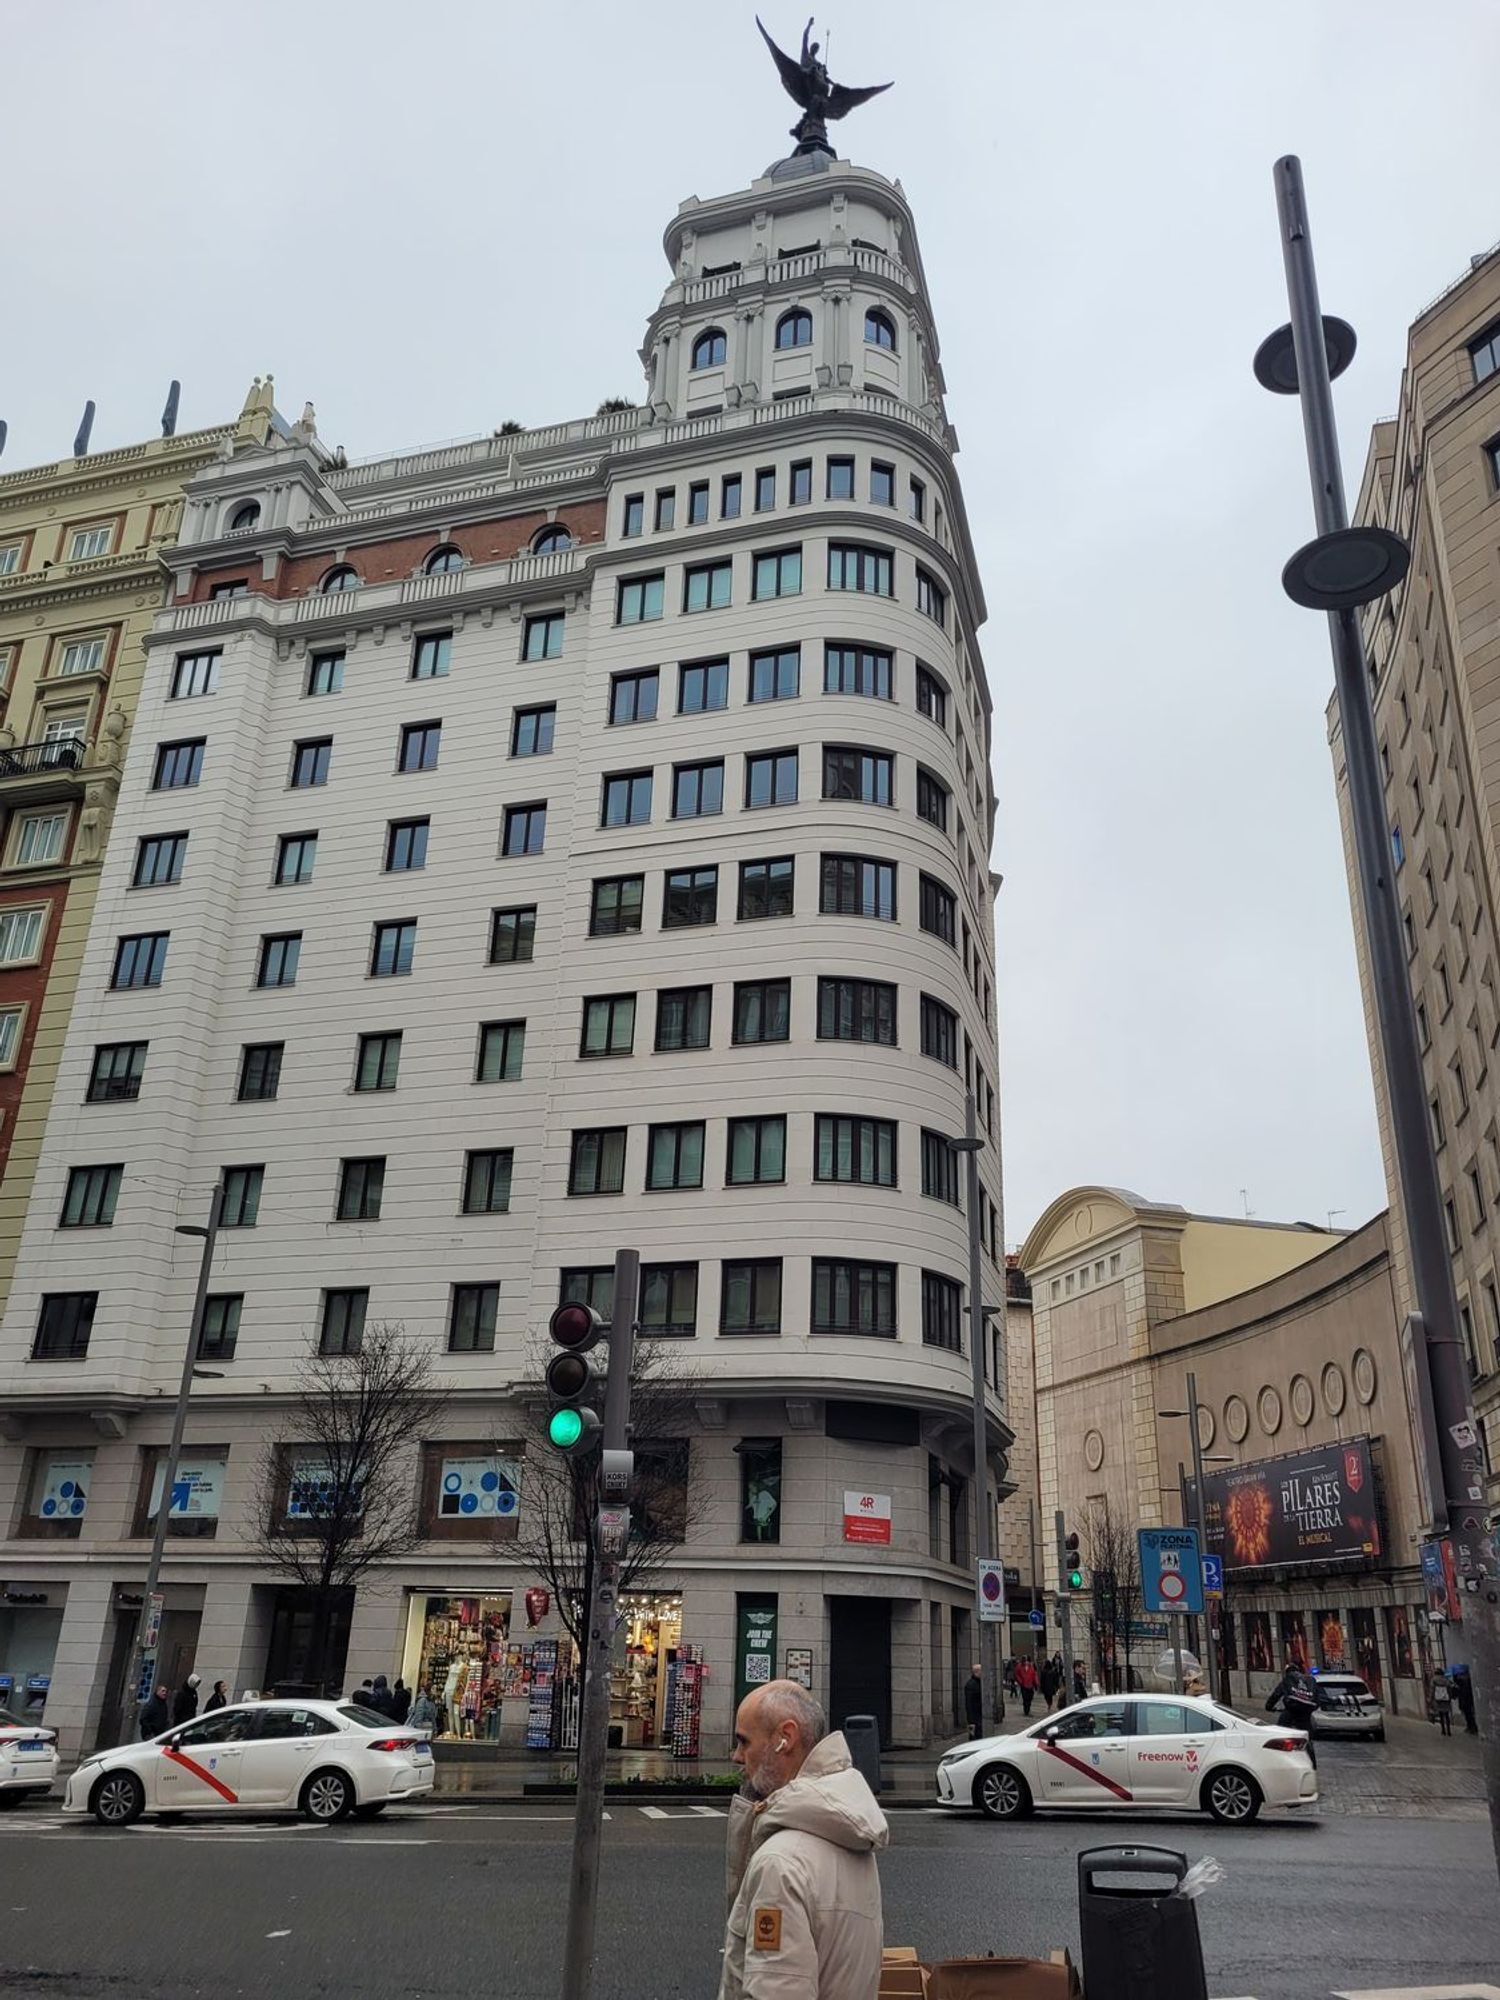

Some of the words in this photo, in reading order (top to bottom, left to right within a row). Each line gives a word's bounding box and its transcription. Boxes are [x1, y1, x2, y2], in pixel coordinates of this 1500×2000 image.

[860, 1496, 875, 1509] 4R
[1281, 1478, 1341, 1513] PILARES
[1296, 1506, 1344, 1532] TIERRA
[1160, 1535, 1193, 1544] ZONA
[1201, 1561, 1217, 1585] P
